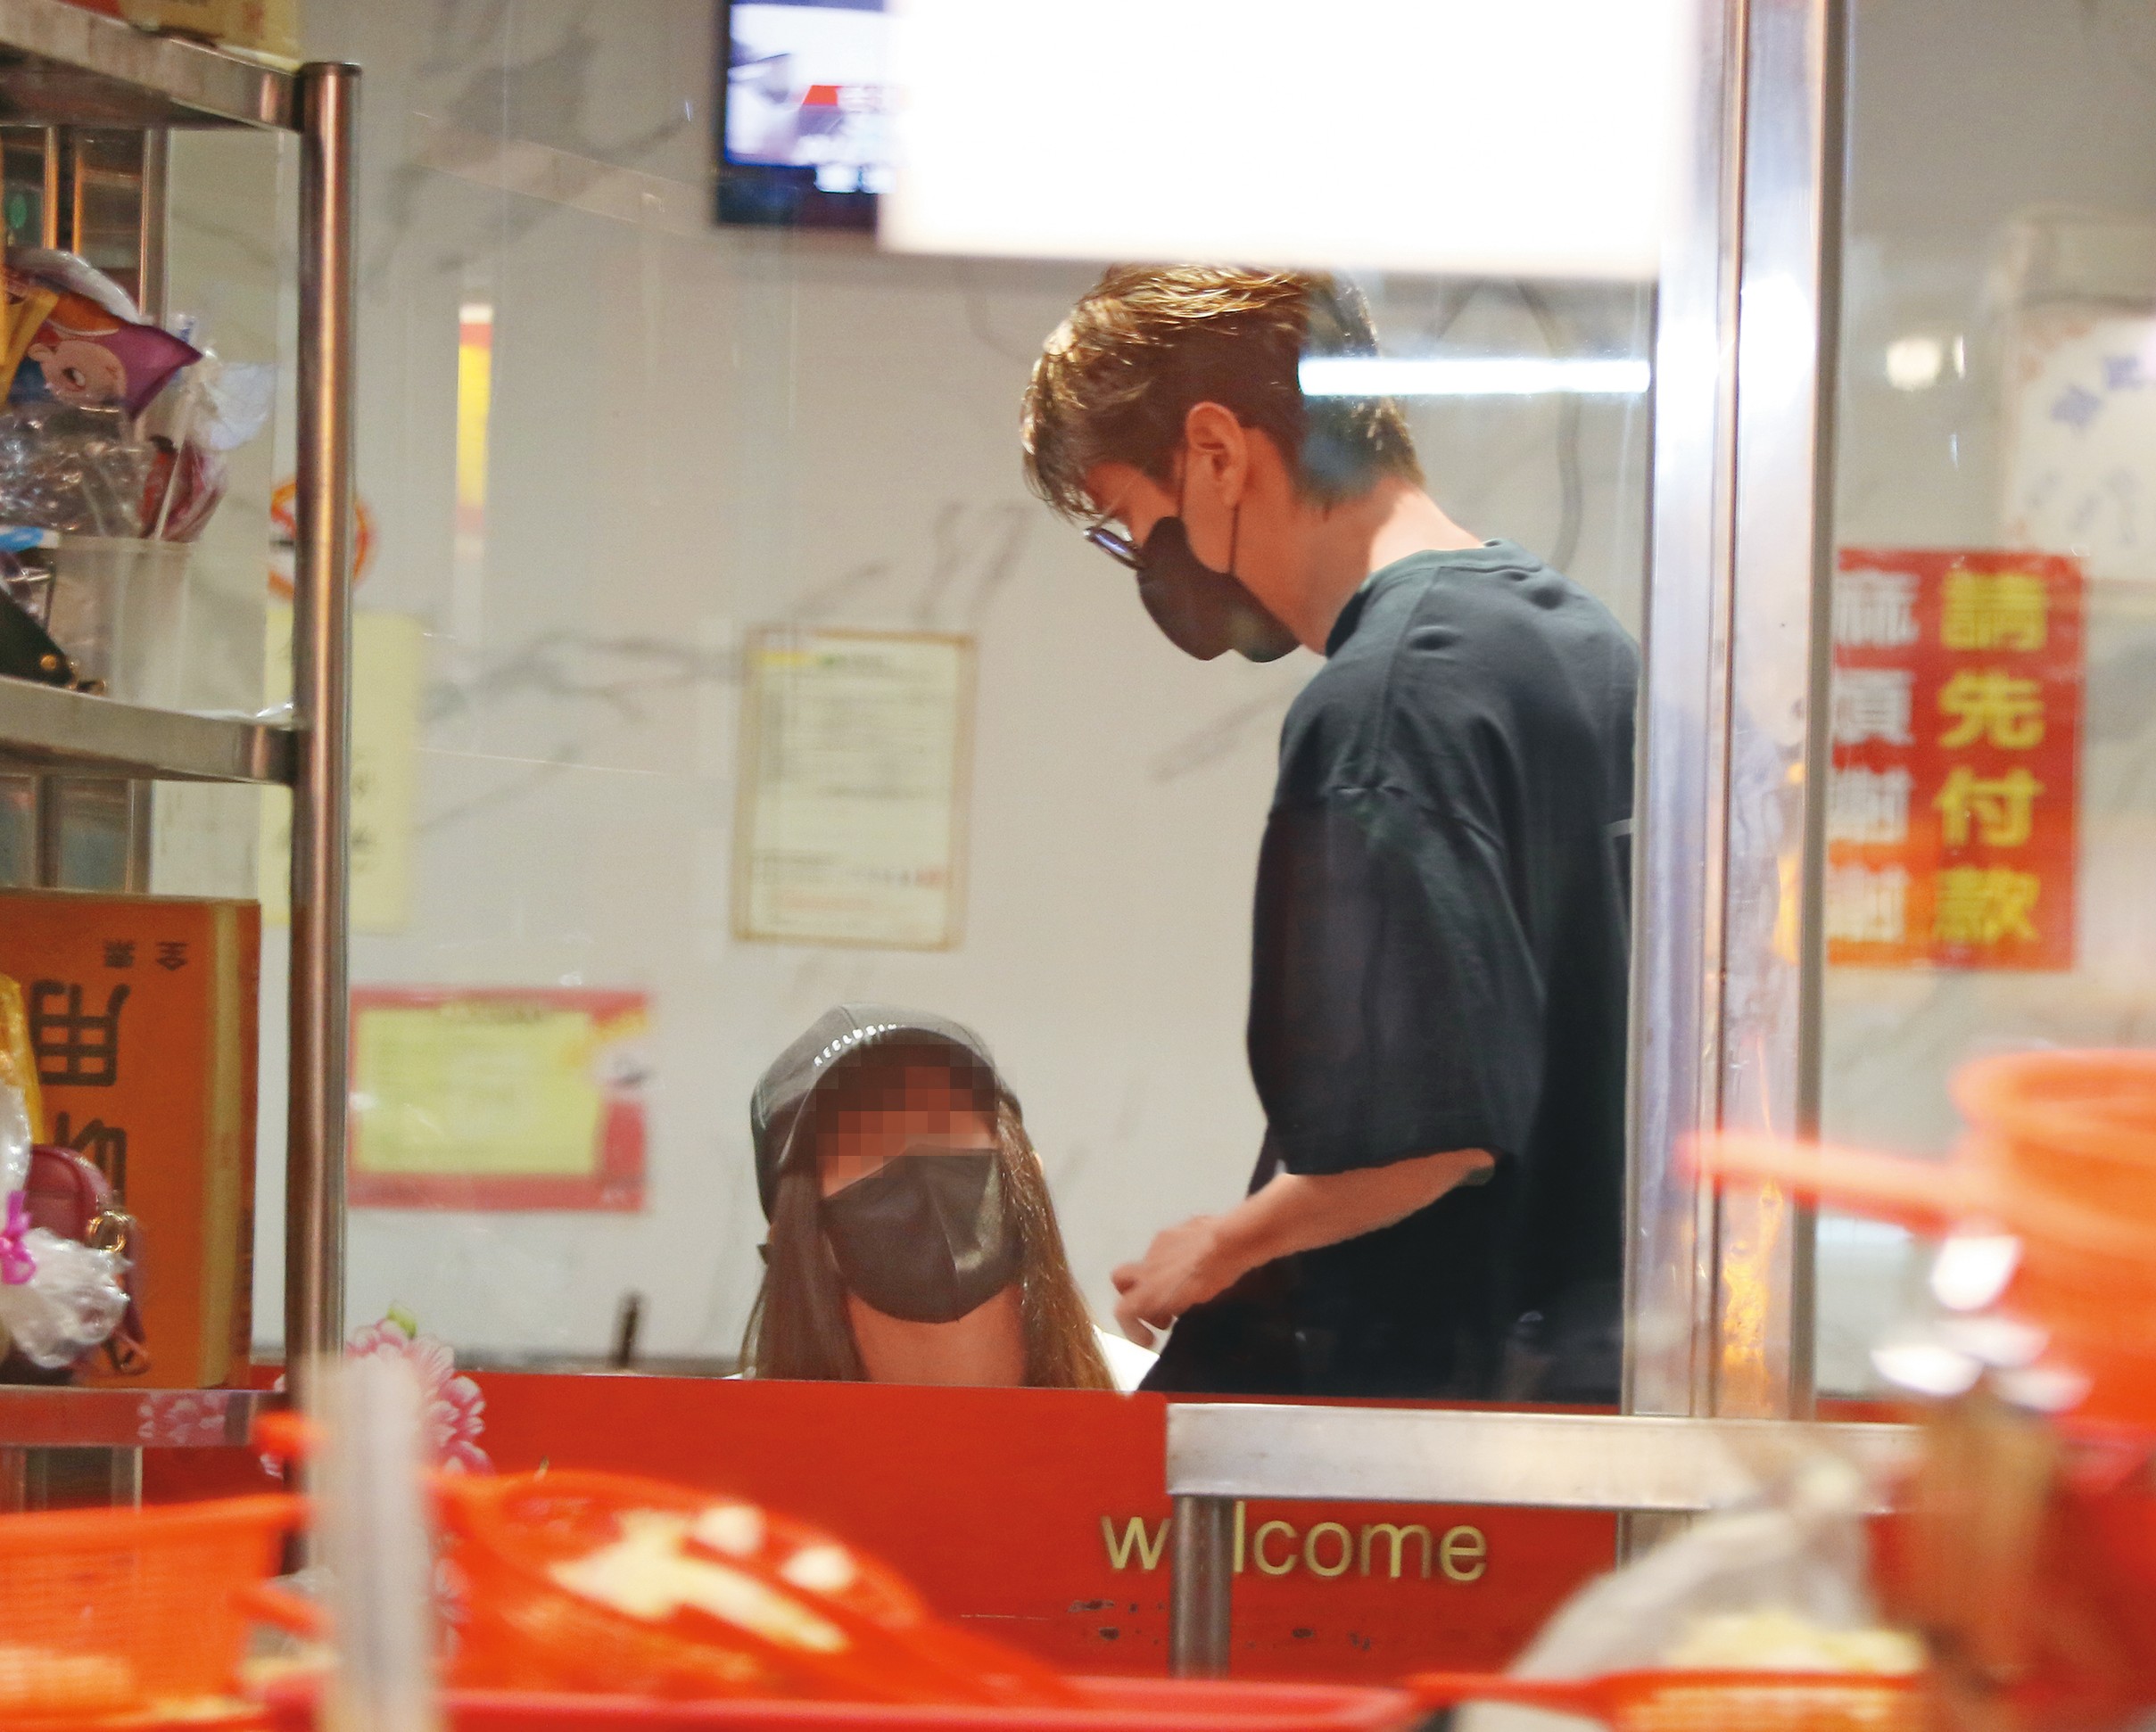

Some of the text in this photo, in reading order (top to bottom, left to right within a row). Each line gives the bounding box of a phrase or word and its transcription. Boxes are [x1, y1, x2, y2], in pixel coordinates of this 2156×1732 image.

[1936, 568, 2047, 945] 請先付款
[1099, 1500, 1489, 1581] wlcome
